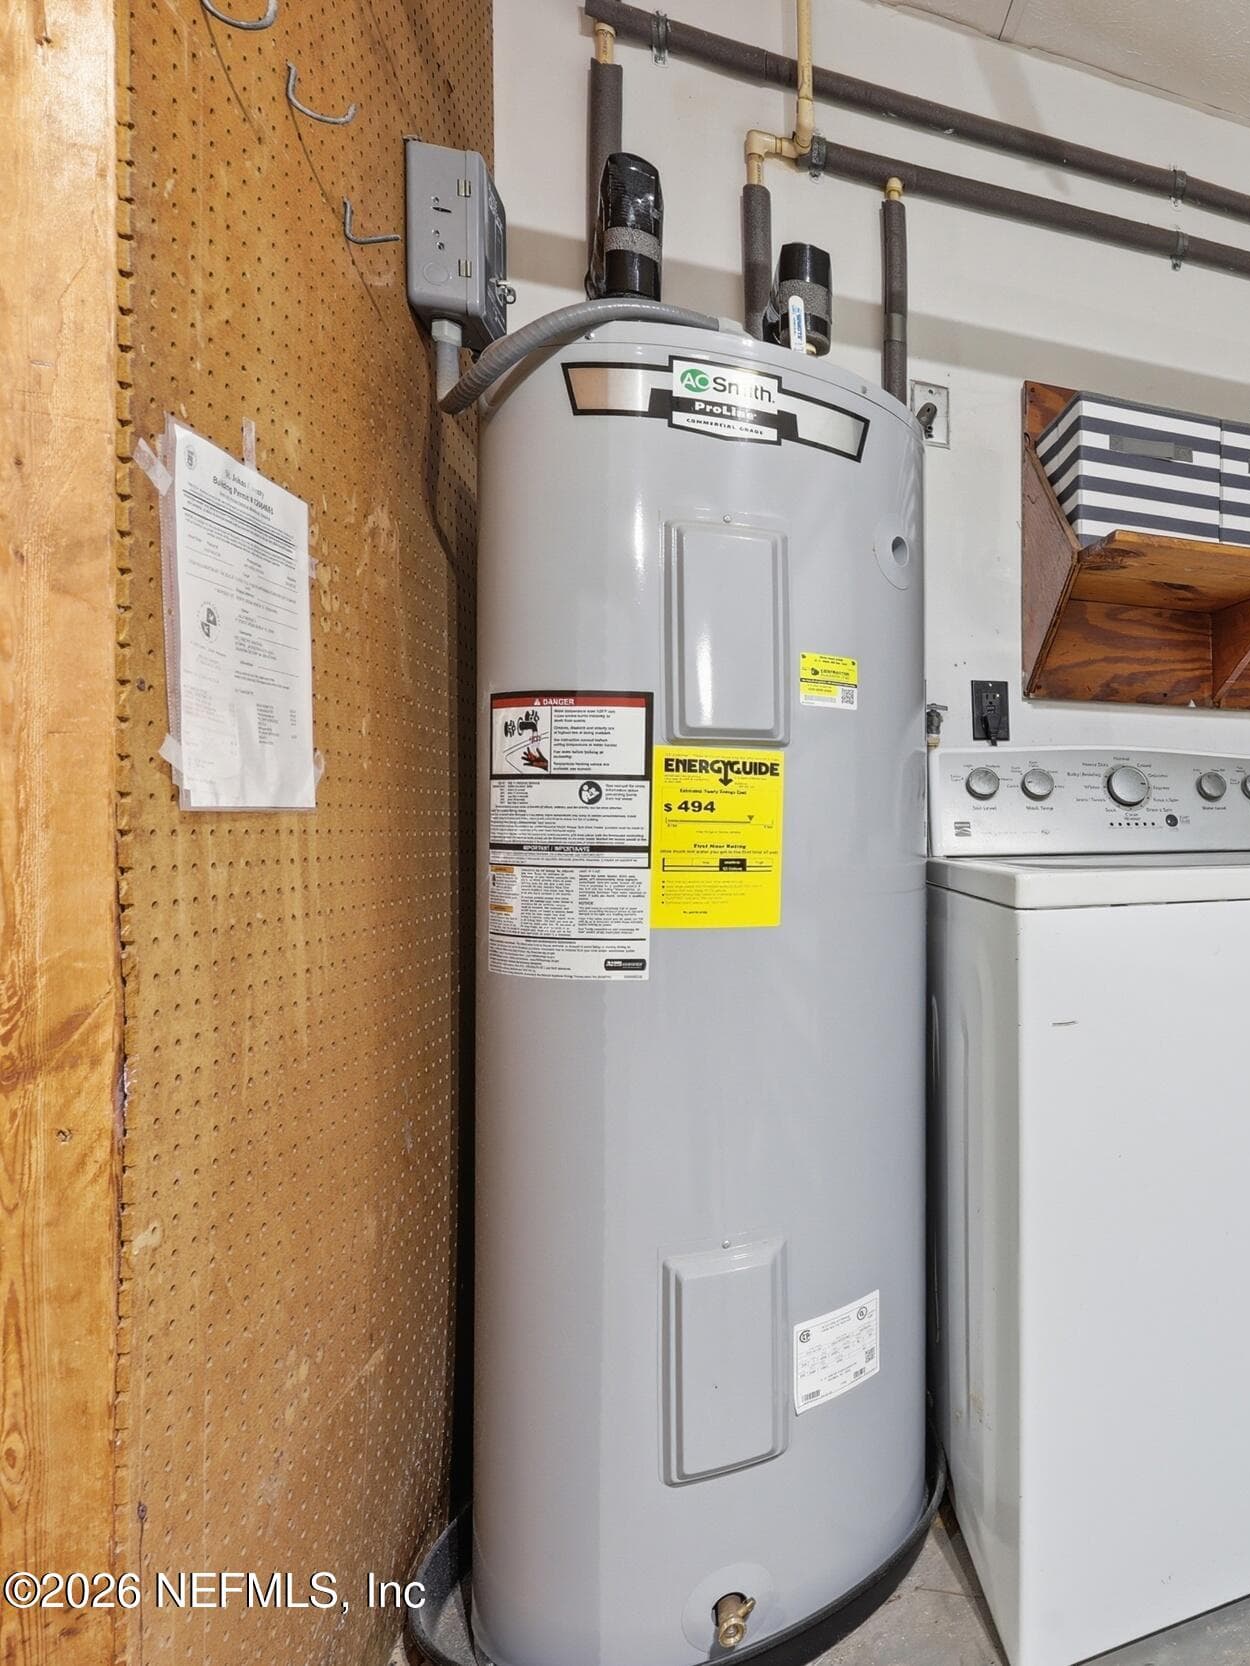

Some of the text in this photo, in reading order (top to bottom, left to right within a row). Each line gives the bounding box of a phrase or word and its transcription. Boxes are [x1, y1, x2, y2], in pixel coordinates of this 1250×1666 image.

[712, 377, 772, 402] Smth
[686, 418, 763, 435] COMMERCIAL GRADE
[542, 698, 575, 706] DANGER
[664, 757, 780, 780] ENERGYGUIDE
[677, 800, 716, 813] 494
